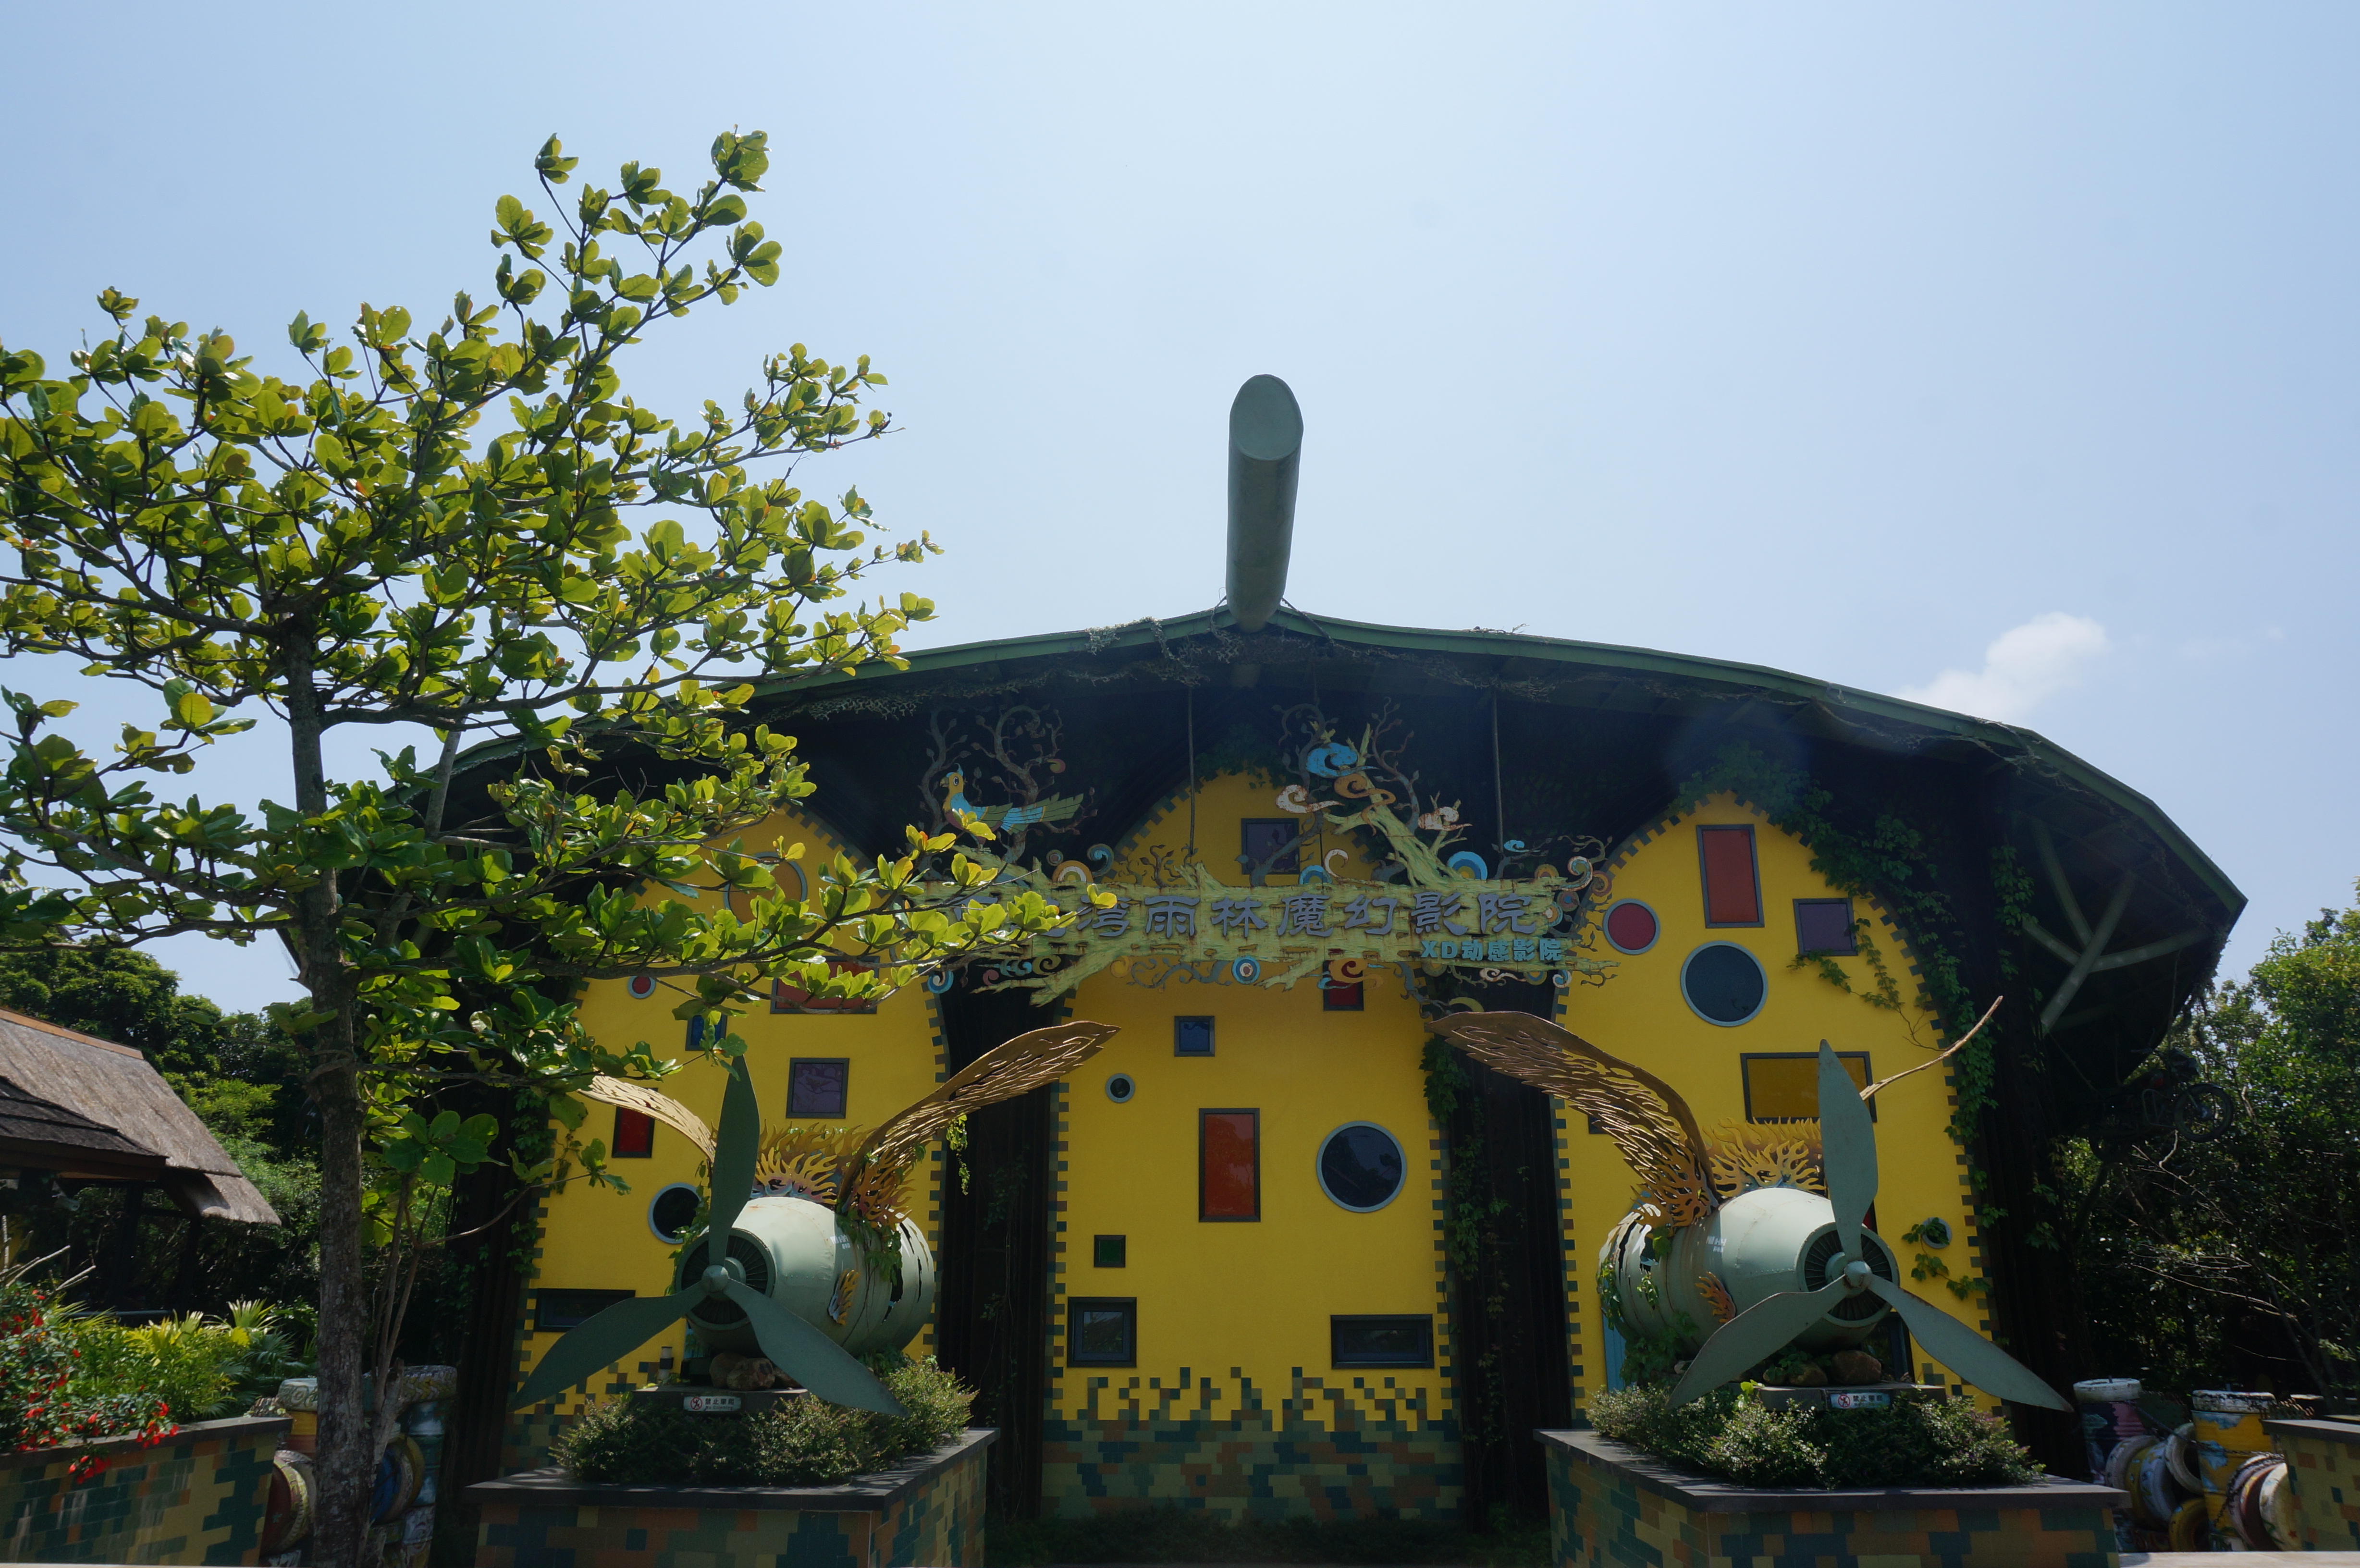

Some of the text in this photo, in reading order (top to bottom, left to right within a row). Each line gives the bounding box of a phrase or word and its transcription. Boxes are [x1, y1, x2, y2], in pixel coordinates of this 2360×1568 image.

[950, 892, 1537, 939] 湾雨林魔幻影院
[1420, 938, 1562, 962] XD动感影院
